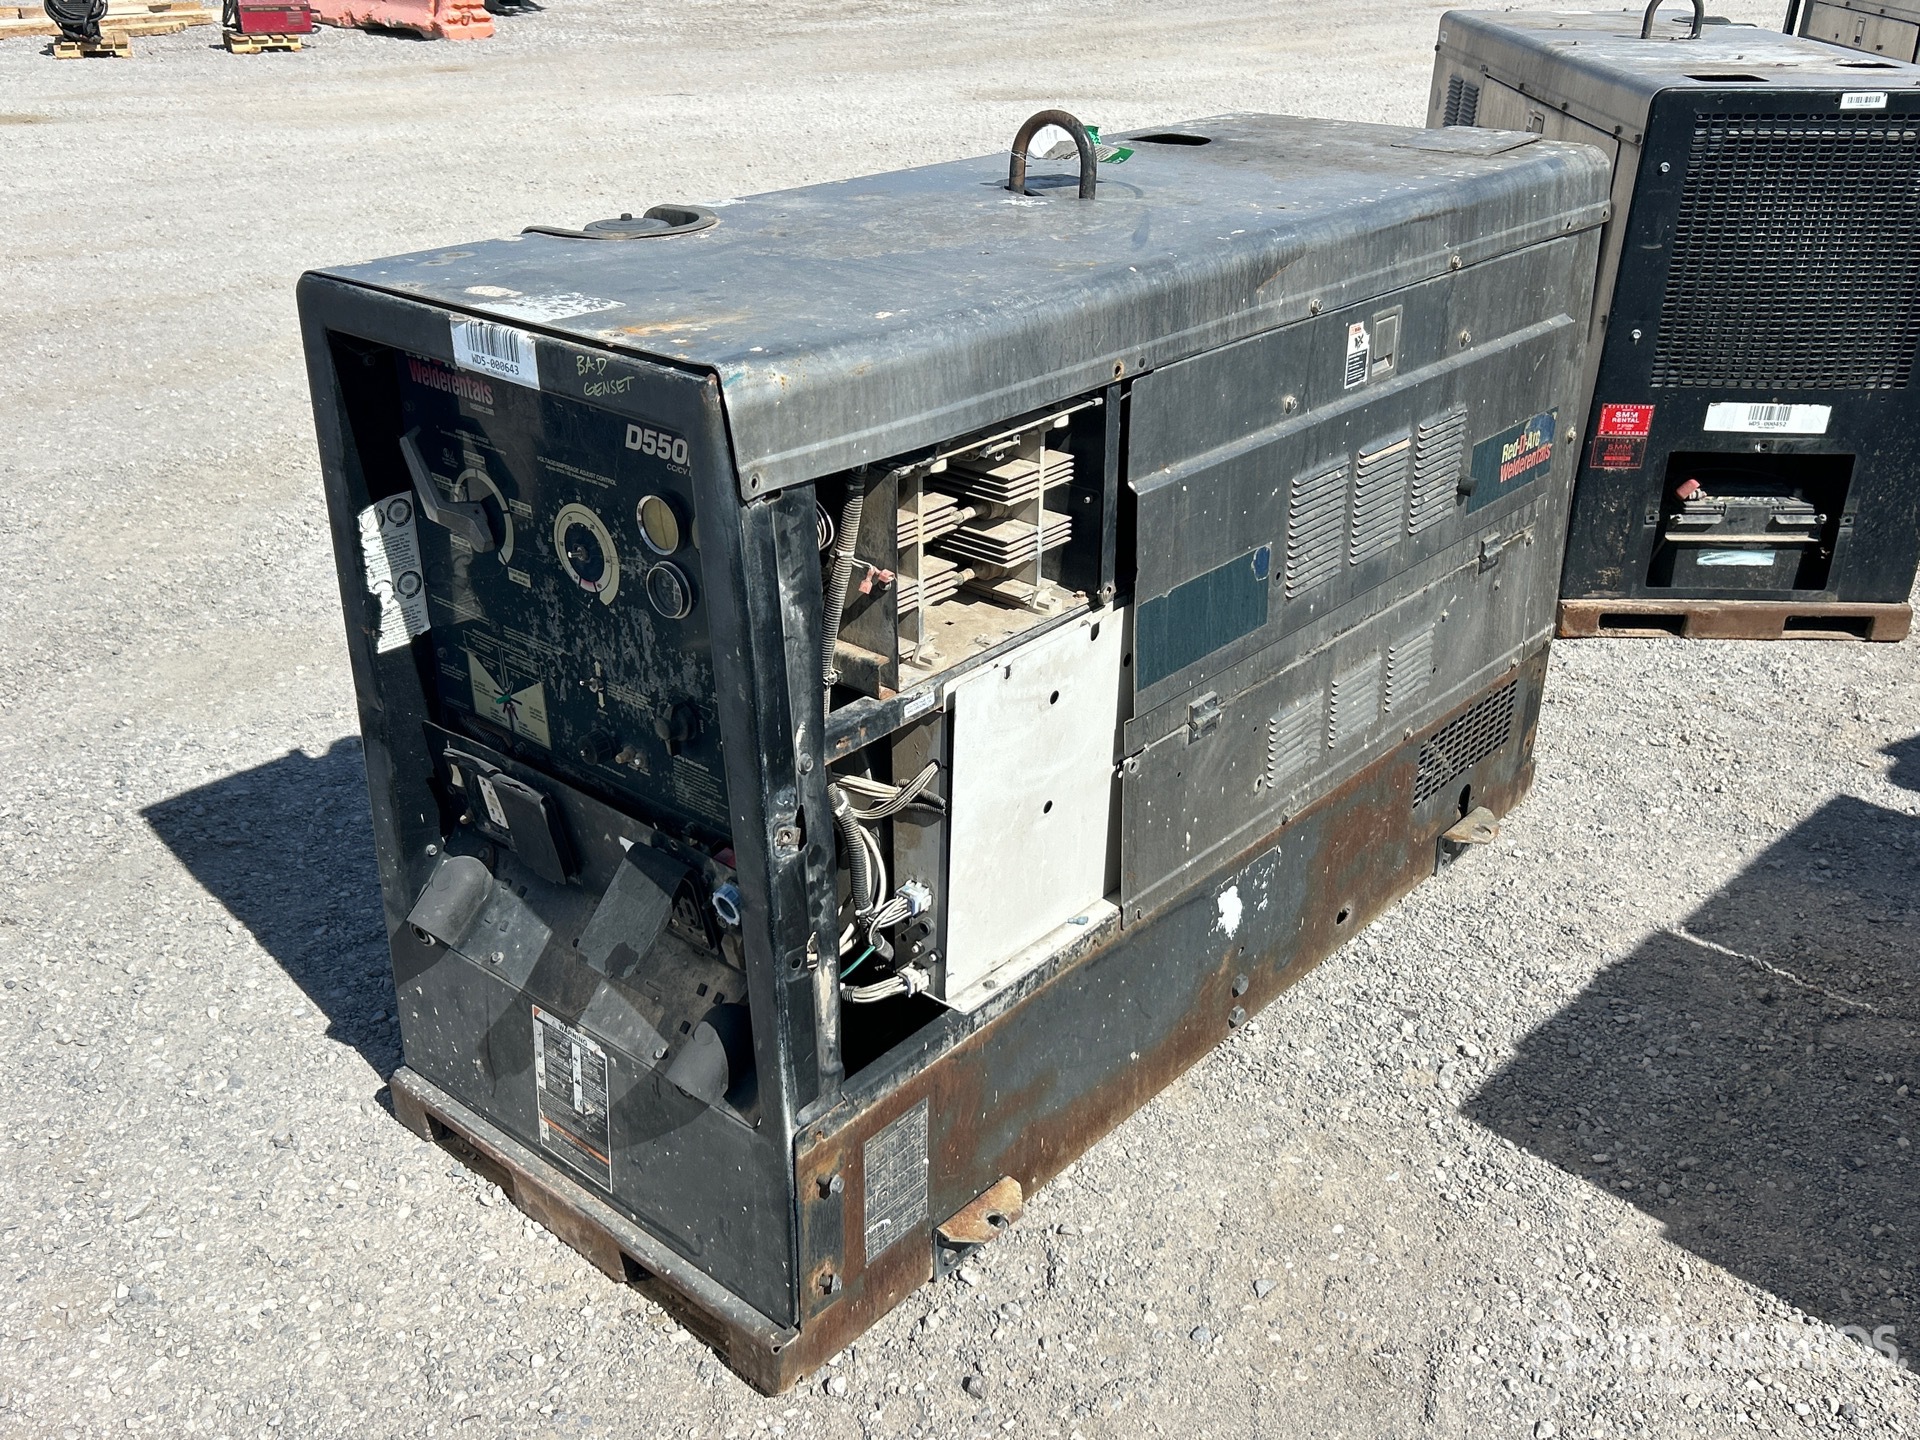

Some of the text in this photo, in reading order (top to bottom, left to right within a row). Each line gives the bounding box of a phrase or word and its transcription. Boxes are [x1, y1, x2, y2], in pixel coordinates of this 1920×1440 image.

[576, 355, 608, 376] BAD
[408, 358, 494, 405] Welderentals
[583, 376, 635, 396] GENSET
[1501, 430, 1541, 463] Red-D-Arc
[1499, 443, 1553, 483] Welderentals
[558, 1023, 588, 1046] WARNING
